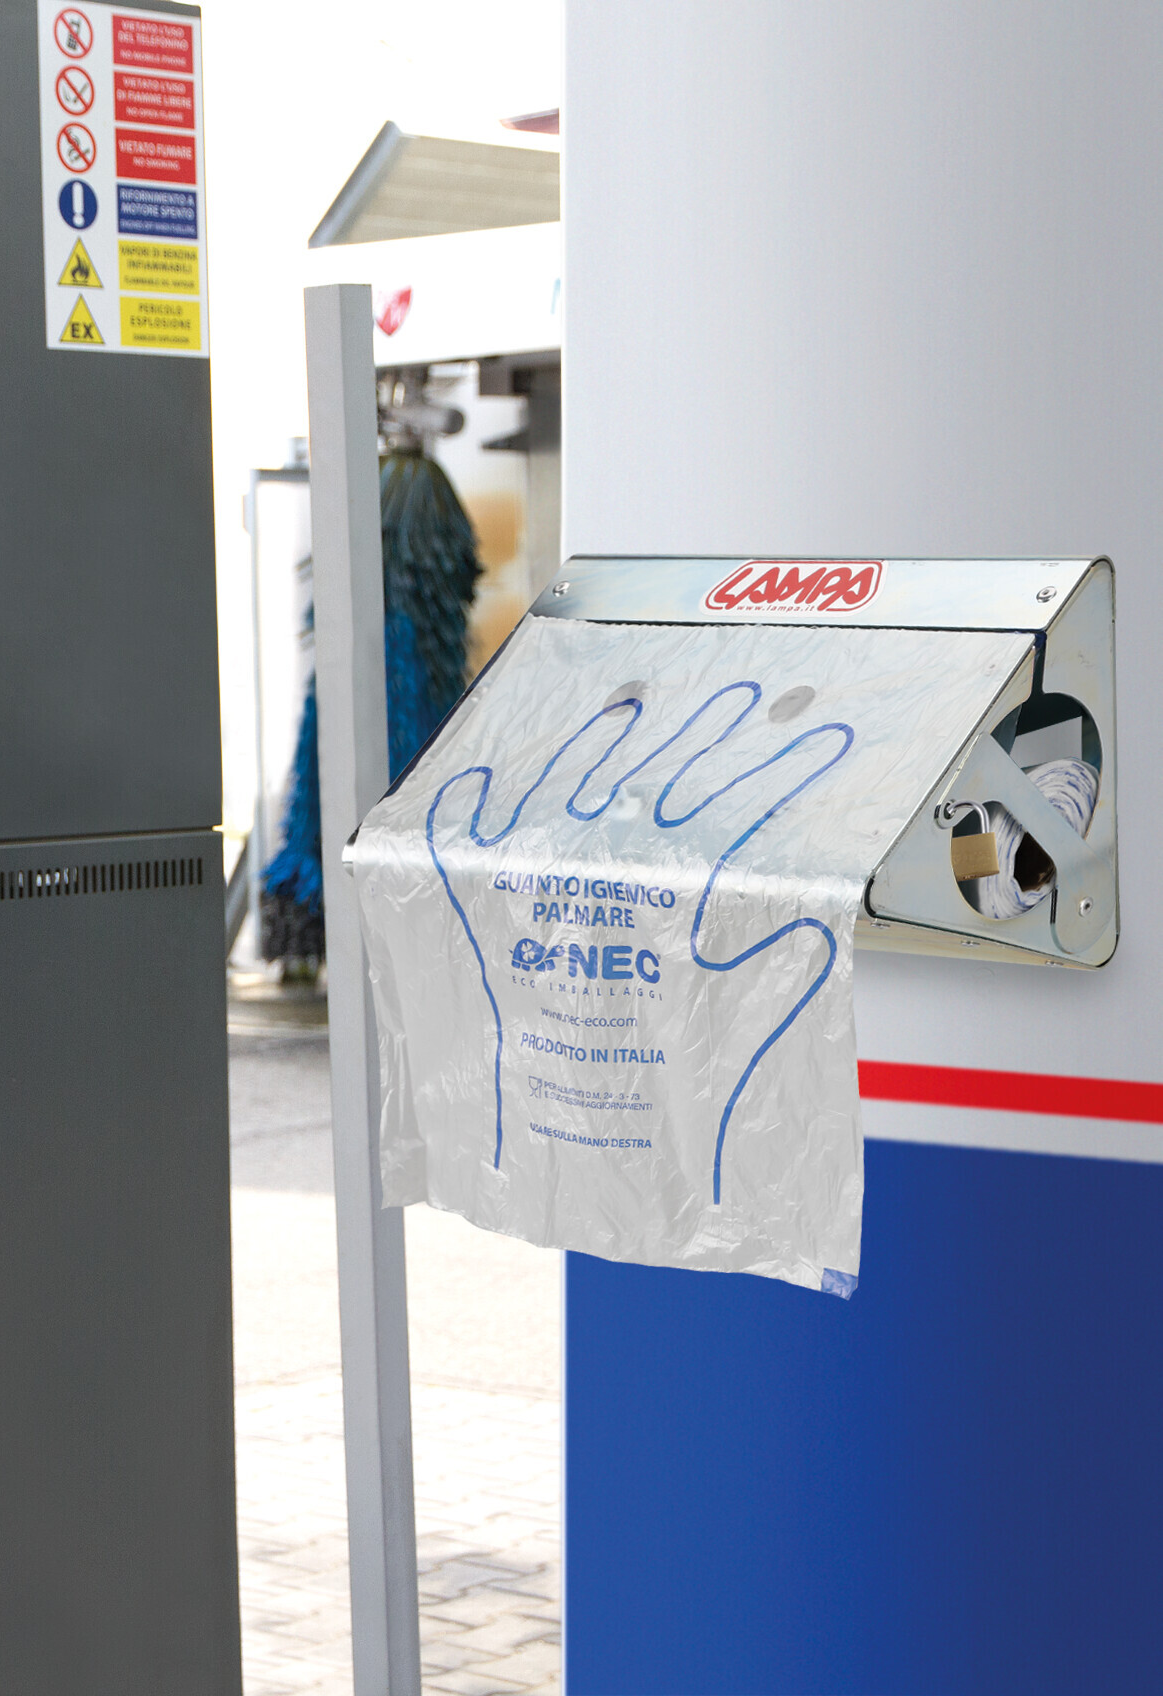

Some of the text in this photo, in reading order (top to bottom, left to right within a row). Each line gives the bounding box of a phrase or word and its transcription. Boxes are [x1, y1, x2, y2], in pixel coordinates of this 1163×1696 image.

[118, 140, 192, 159] VIETATO FUMARE
[71, 322, 94, 339] EX
[714, 567, 874, 611] LAMPA
[737, 604, 814, 612] www.lampa.it
[494, 871, 676, 908] GUANTO IGIENICO
[533, 902, 635, 928] PALMARE
[568, 943, 660, 984] NEC
[512, 976, 663, 1001] ECO IMBALLAGGI
[521, 1032, 666, 1064] PRODOTTO IN ITALIA
[585, 1100, 653, 1111] AGGIORNAMENTI
[553, 1130, 578, 1144] SULLA
[578, 1136, 609, 1148] MANO
[610, 1138, 652, 1148] DESTRA
